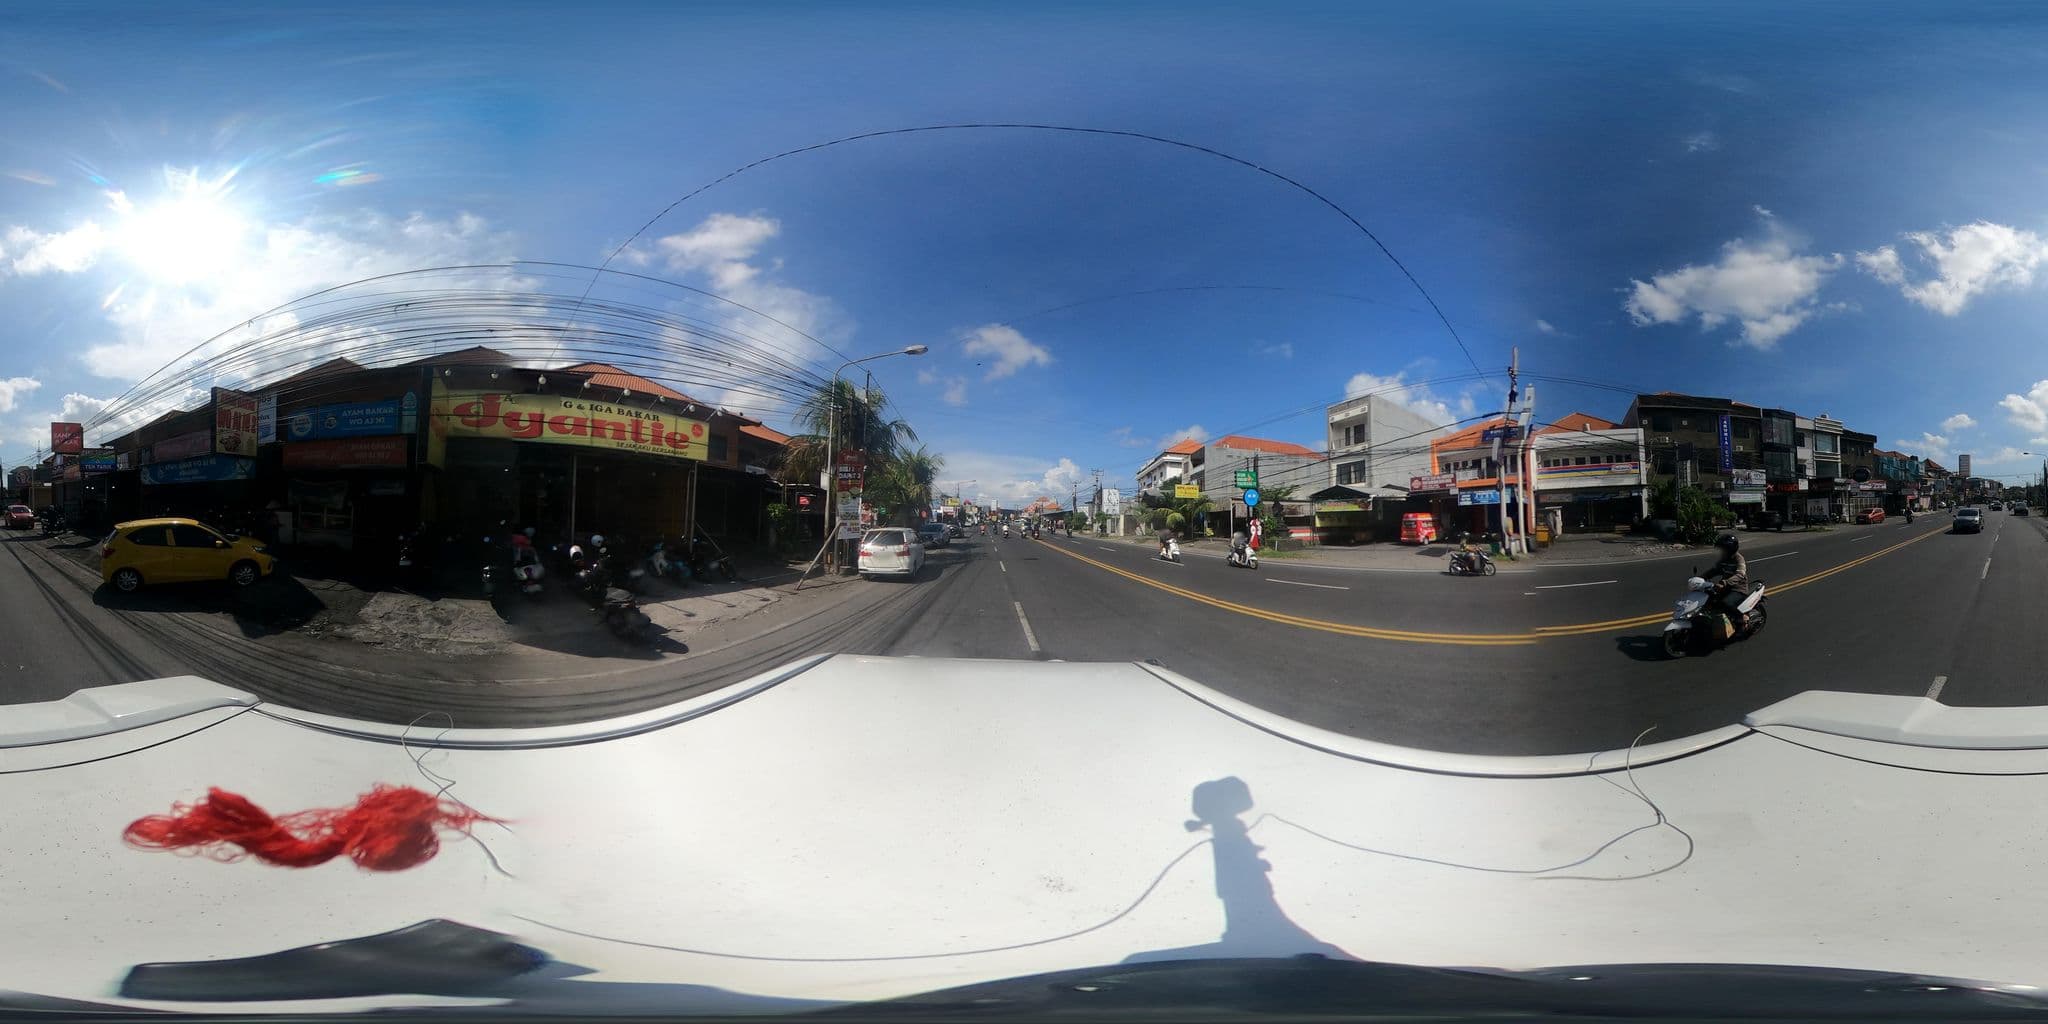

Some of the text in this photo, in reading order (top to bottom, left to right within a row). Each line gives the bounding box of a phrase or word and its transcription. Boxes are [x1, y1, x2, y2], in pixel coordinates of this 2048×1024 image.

[342, 408, 365, 417] AYAM
[589, 403, 614, 414] IGA
[617, 408, 660, 422] BAKAR
